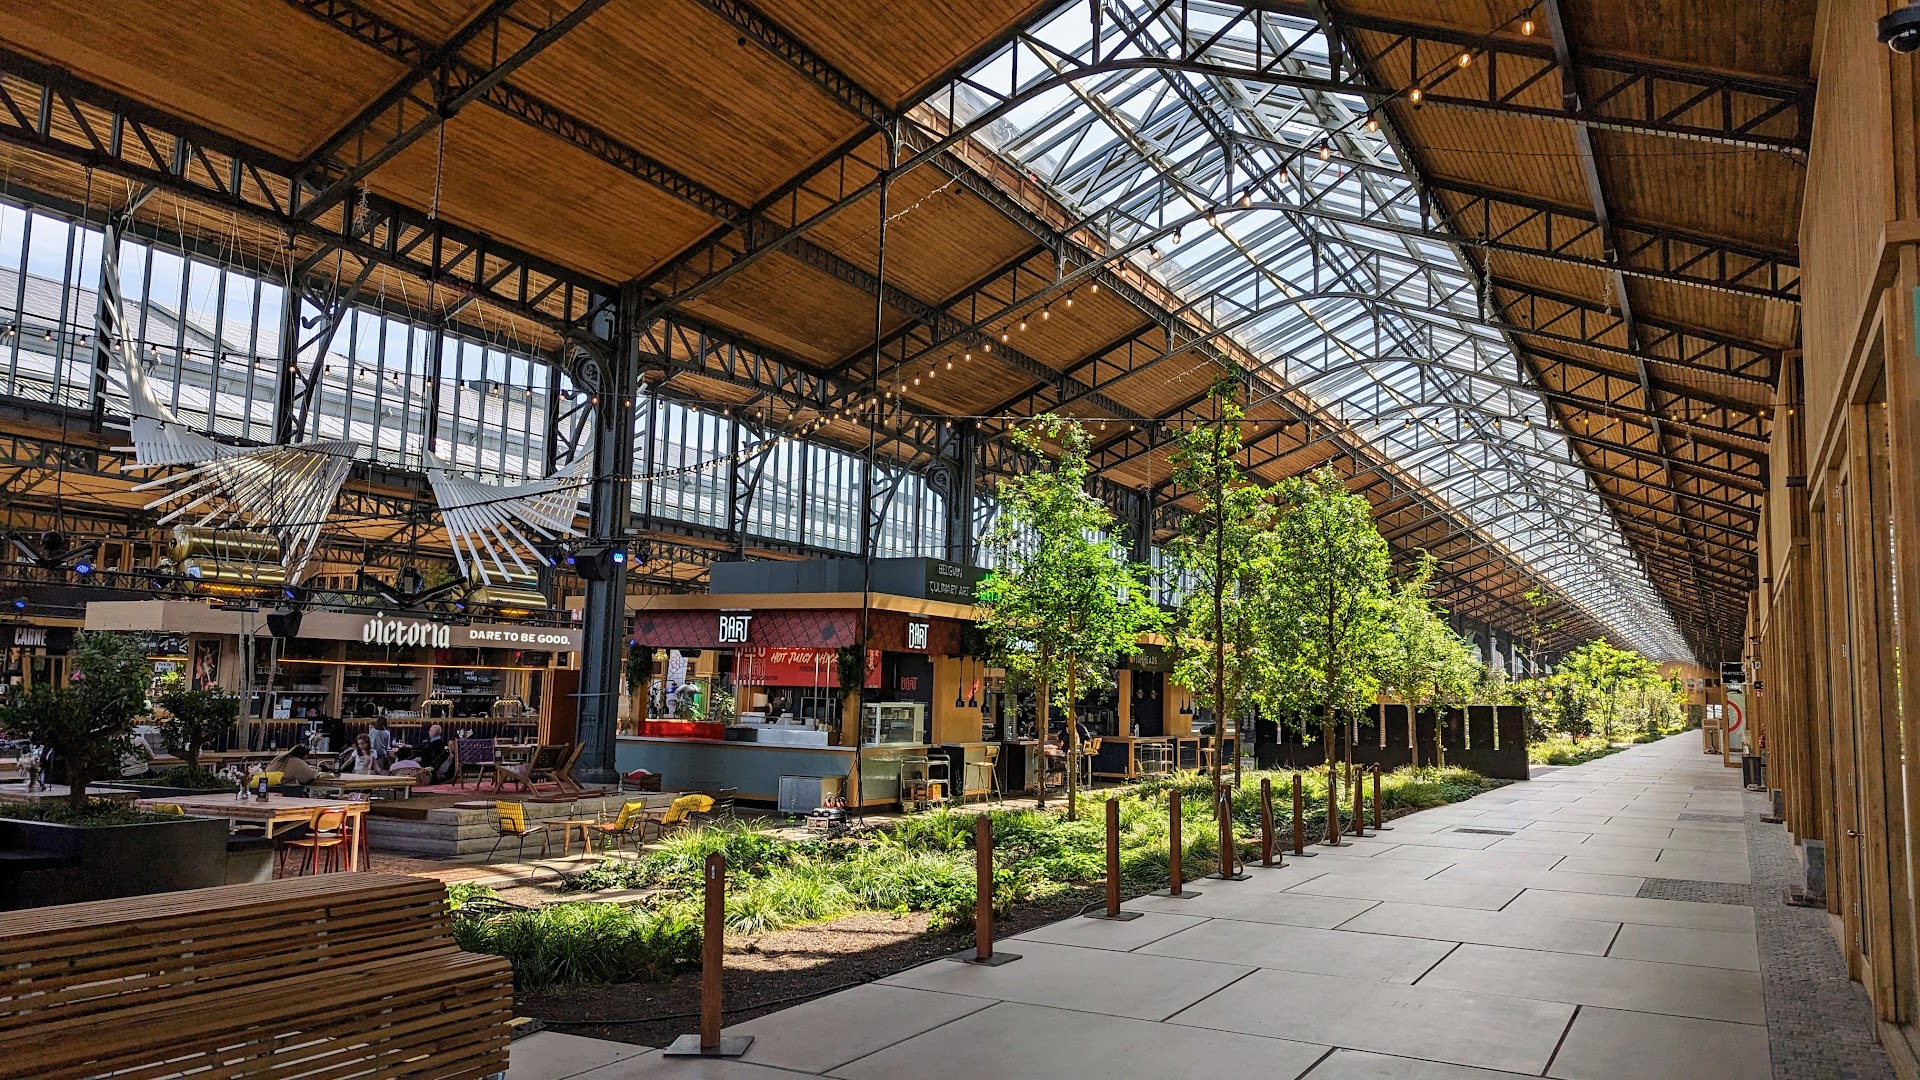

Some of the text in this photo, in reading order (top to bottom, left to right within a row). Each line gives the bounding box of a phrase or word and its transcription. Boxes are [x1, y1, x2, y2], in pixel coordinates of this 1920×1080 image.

[958, 585, 970, 597] ART
[14, 627, 48, 647] CARNE
[362, 610, 571, 649] victoria DARE TO BE GOOD.
[718, 615, 753, 643] BART
[908, 622, 930, 650] BART
[770, 651, 788, 664] HOT
[900, 676, 919, 691] BART
